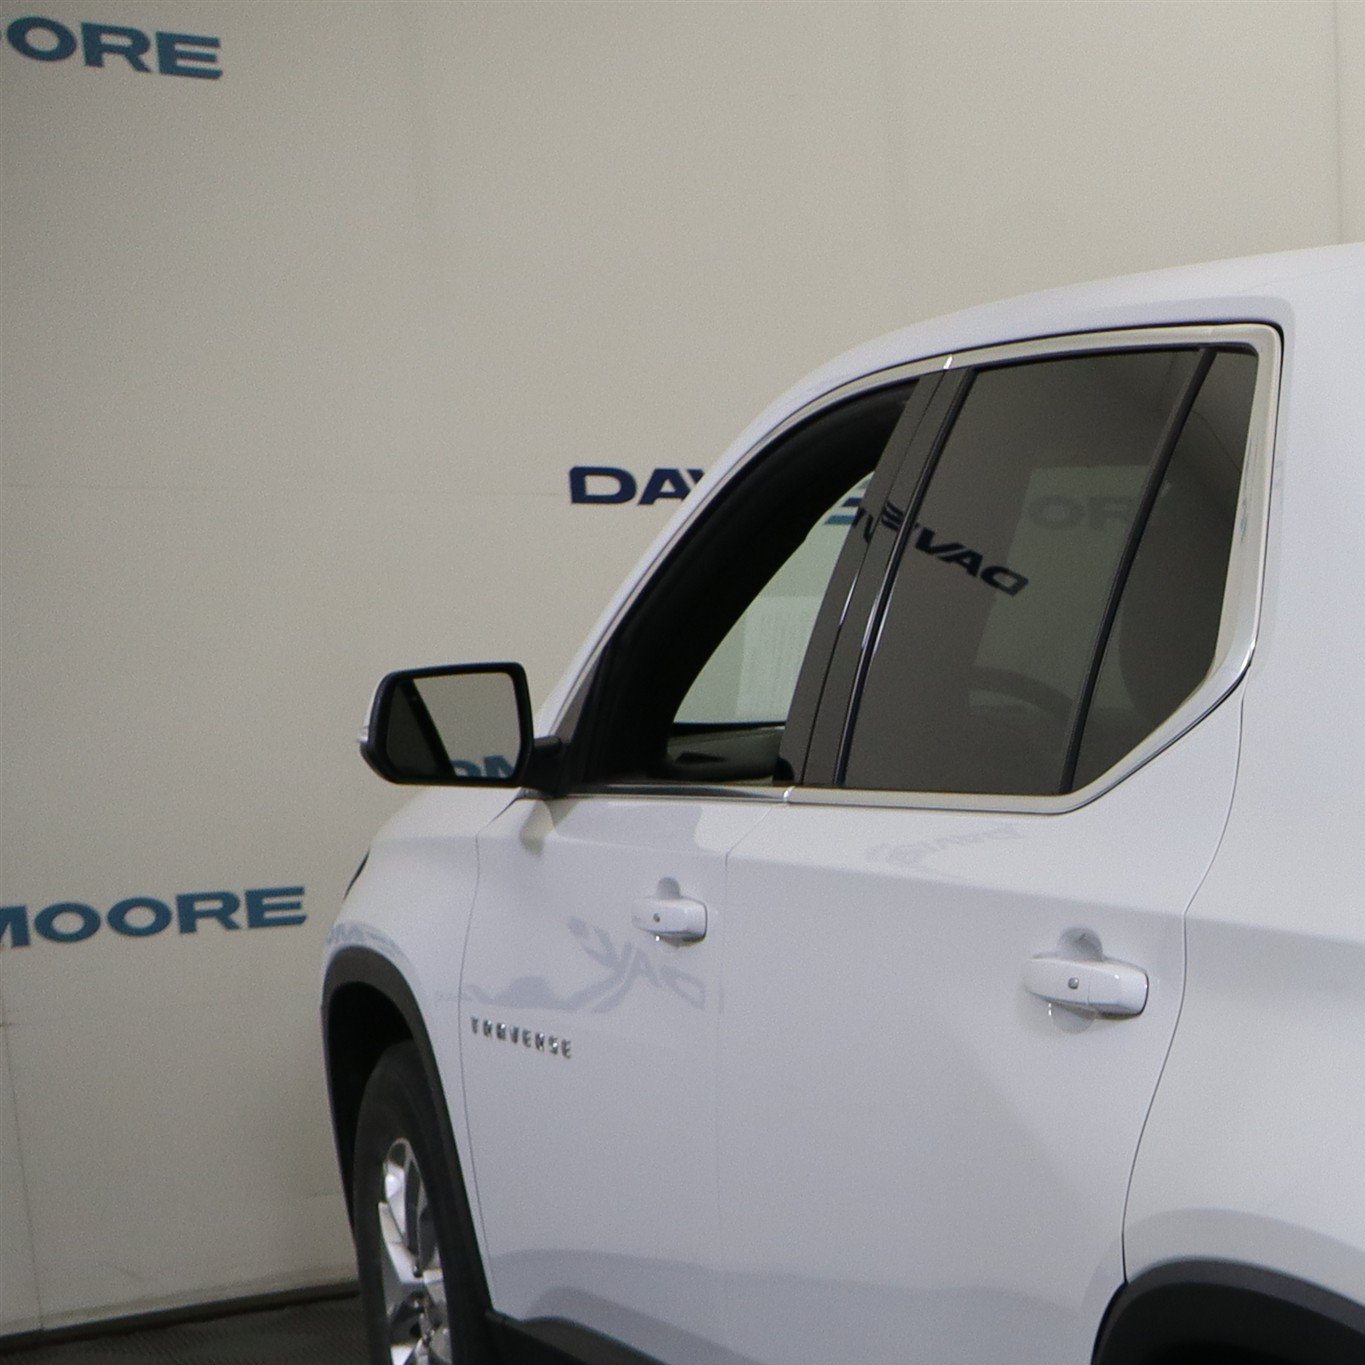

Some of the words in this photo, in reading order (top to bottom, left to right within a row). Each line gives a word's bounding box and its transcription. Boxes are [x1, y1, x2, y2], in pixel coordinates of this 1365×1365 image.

[0, 16, 223, 80] ORE
[569, 465, 706, 506] DA
[470, 1016, 571, 1059] TRAVERSE
